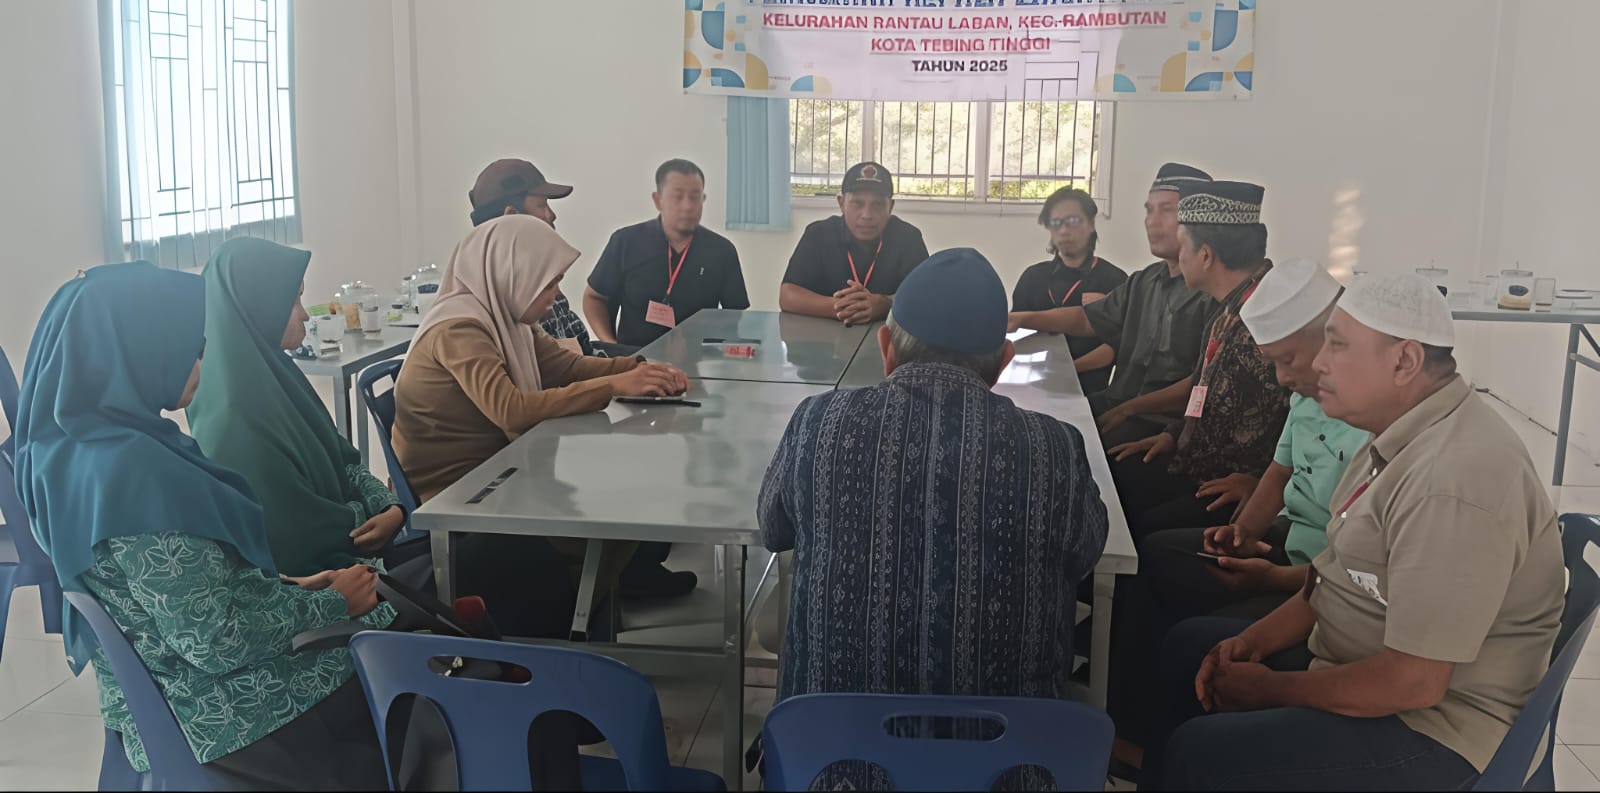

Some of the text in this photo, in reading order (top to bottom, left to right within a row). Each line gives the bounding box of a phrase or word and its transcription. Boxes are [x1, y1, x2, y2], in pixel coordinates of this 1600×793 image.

[763, 13, 868, 28] KELURAHAN
[873, 16, 943, 29] RANTAU
[948, 16, 1012, 30] LABAN,
[1062, 11, 1166, 27] RAMBUTAN
[871, 37, 1051, 52] KOTA TEBING TINGGI
[912, 60, 1008, 72] TAHUN 2025
